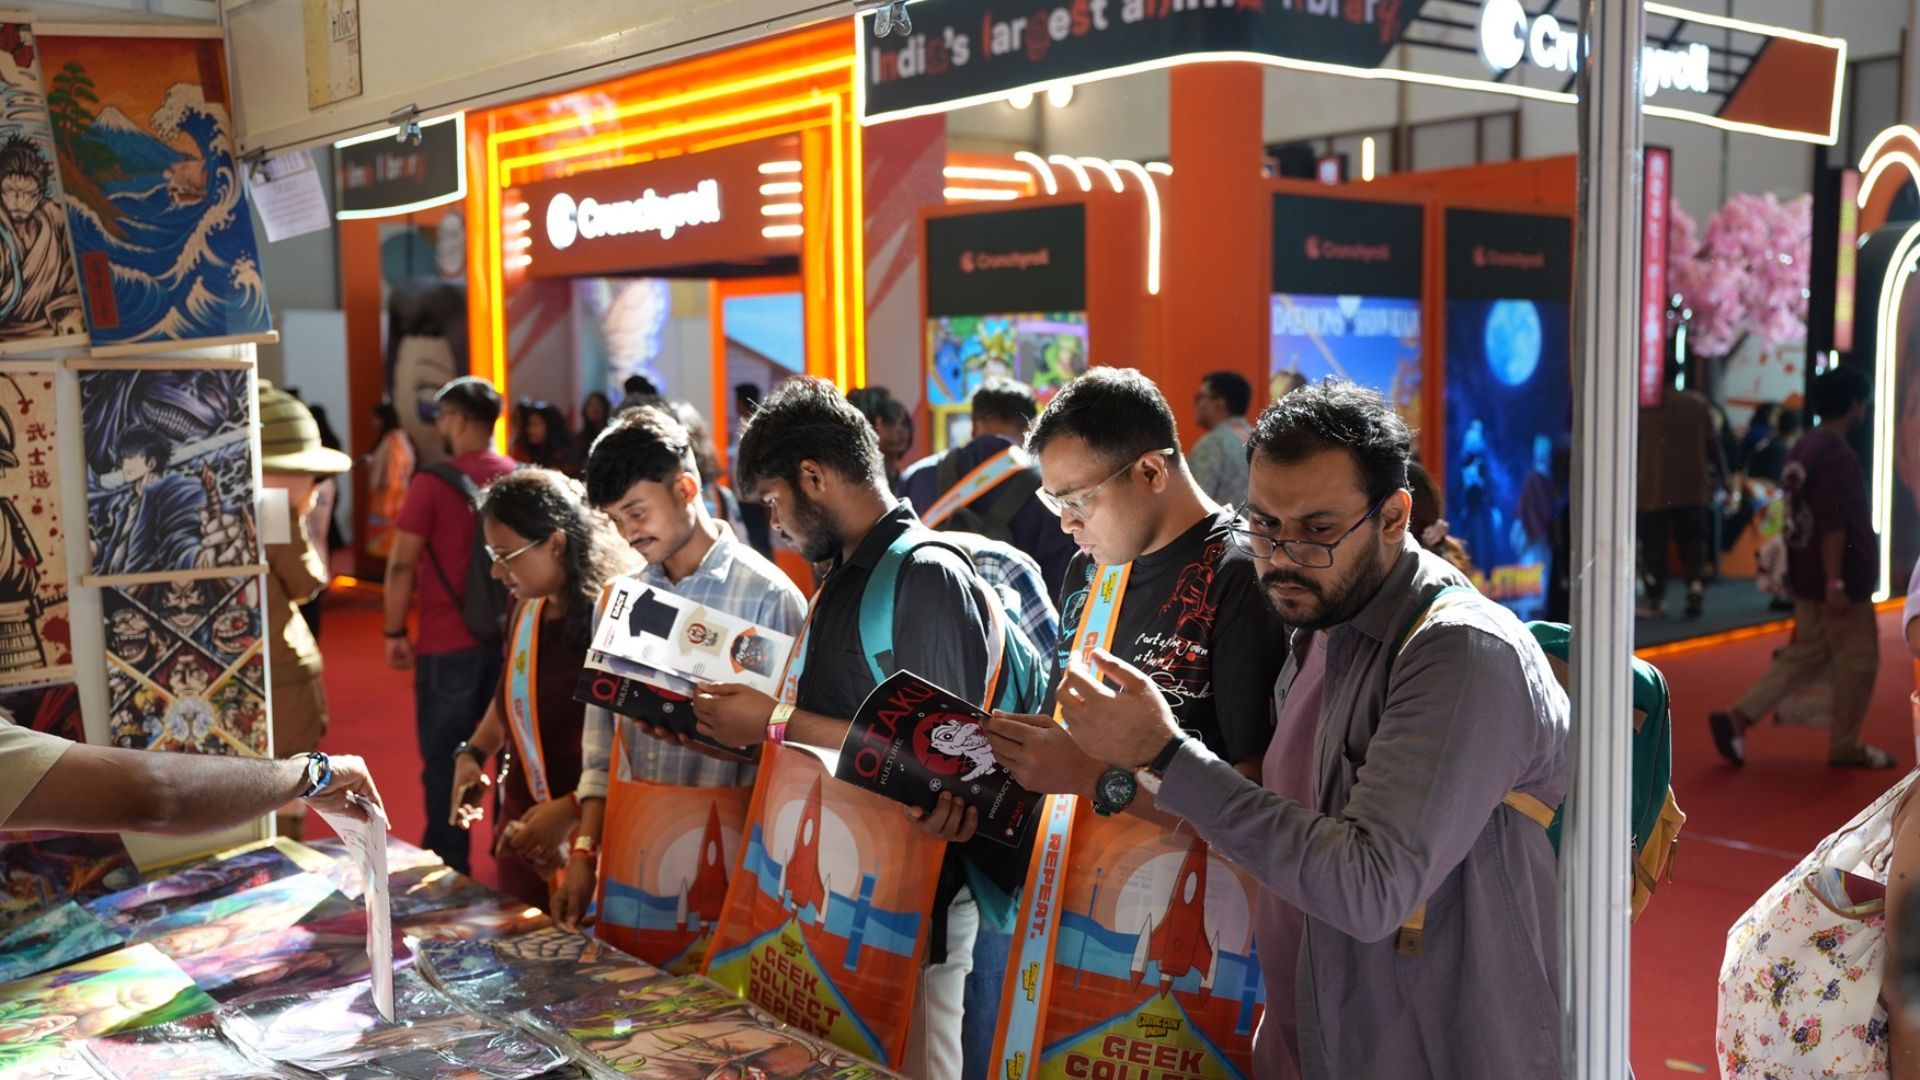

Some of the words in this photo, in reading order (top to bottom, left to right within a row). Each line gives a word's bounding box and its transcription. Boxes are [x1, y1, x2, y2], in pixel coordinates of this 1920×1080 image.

[872, 27, 970, 84] India's
[982, 0, 1108, 60] largest
[976, 249, 1049, 270] Crunchyroll
[26, 422, 51, 489] 武士道
[854, 681, 934, 778] OTAKU
[880, 738, 904, 785] KULTURE
[989, 780, 1012, 819] PRODUCT
[1030, 834, 1062, 939] REPEAT.
[751, 954, 842, 1027] COLLECT
[766, 945, 819, 997] GEEK
[1102, 1035, 1205, 1074] GEEK
